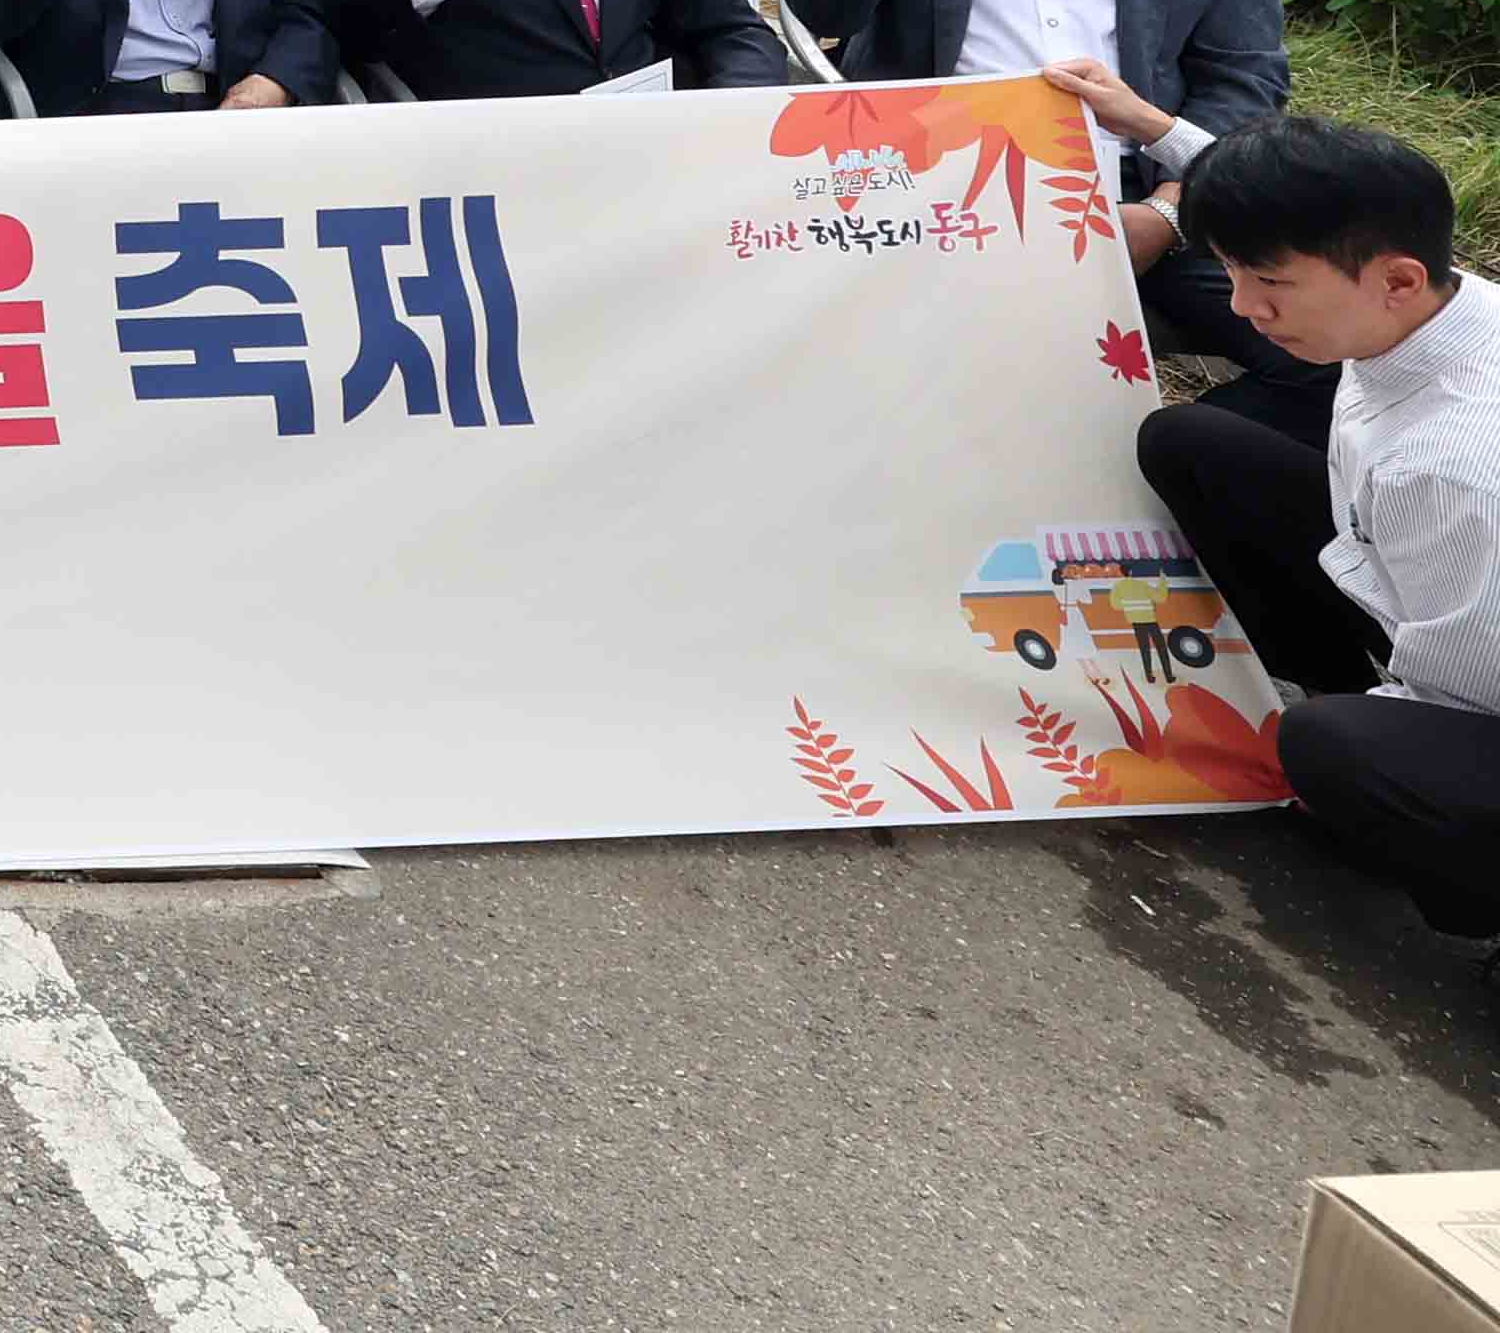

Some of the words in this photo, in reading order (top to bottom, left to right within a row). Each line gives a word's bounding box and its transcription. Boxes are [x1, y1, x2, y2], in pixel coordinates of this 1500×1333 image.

[793, 177, 827, 202] 살고
[831, 171, 865, 198] 싶은
[866, 169, 916, 192] 도시!
[726, 219, 804, 260] 활기찬
[805, 214, 923, 255] 행복도시
[924, 201, 999, 254] 동구
[116, 195, 534, 435] 축제
